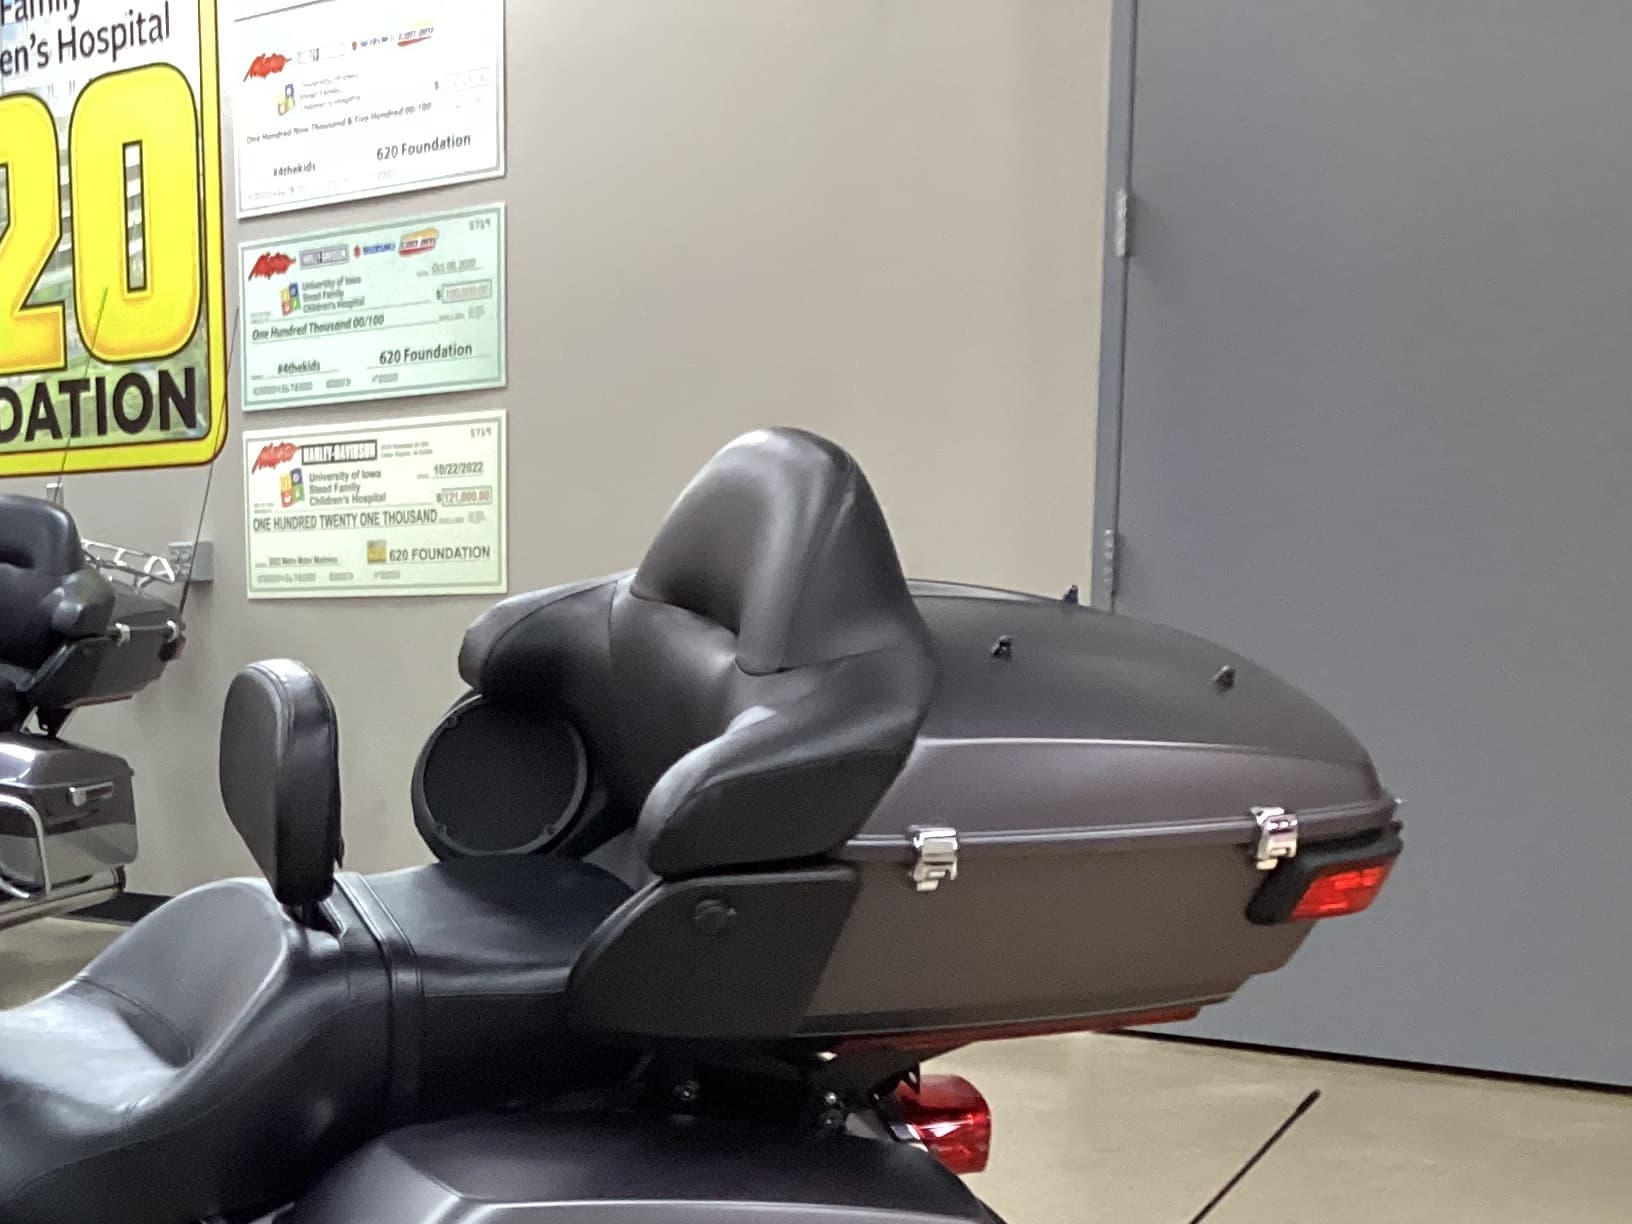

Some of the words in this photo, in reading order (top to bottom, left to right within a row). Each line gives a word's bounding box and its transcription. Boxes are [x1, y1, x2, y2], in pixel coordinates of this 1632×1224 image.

[57, 1, 170, 64] Hospital
[376, 146, 399, 161] 620
[401, 133, 472, 157] Foundation
[252, 329, 269, 341] One
[270, 322, 307, 338] Hundred
[309, 319, 352, 333] Thousand
[379, 350, 401, 365] 620
[403, 343, 473, 362] Foundation
[309, 470, 350, 484] University
[362, 470, 381, 479] Iowa
[433, 461, 484, 476] 10/22/2022
[334, 482, 361, 496] Family
[309, 494, 350, 506] Children's
[351, 492, 386, 505] Hospital
[253, 517, 272, 531] ONE
[273, 514, 317, 530] HUNDRED
[319, 512, 358, 528] TWENTY
[359, 511, 380, 526] ONE
[382, 509, 438, 525] THOUSAND
[389, 549, 409, 562] 620
[411, 546, 491, 560] FOUNDATION
